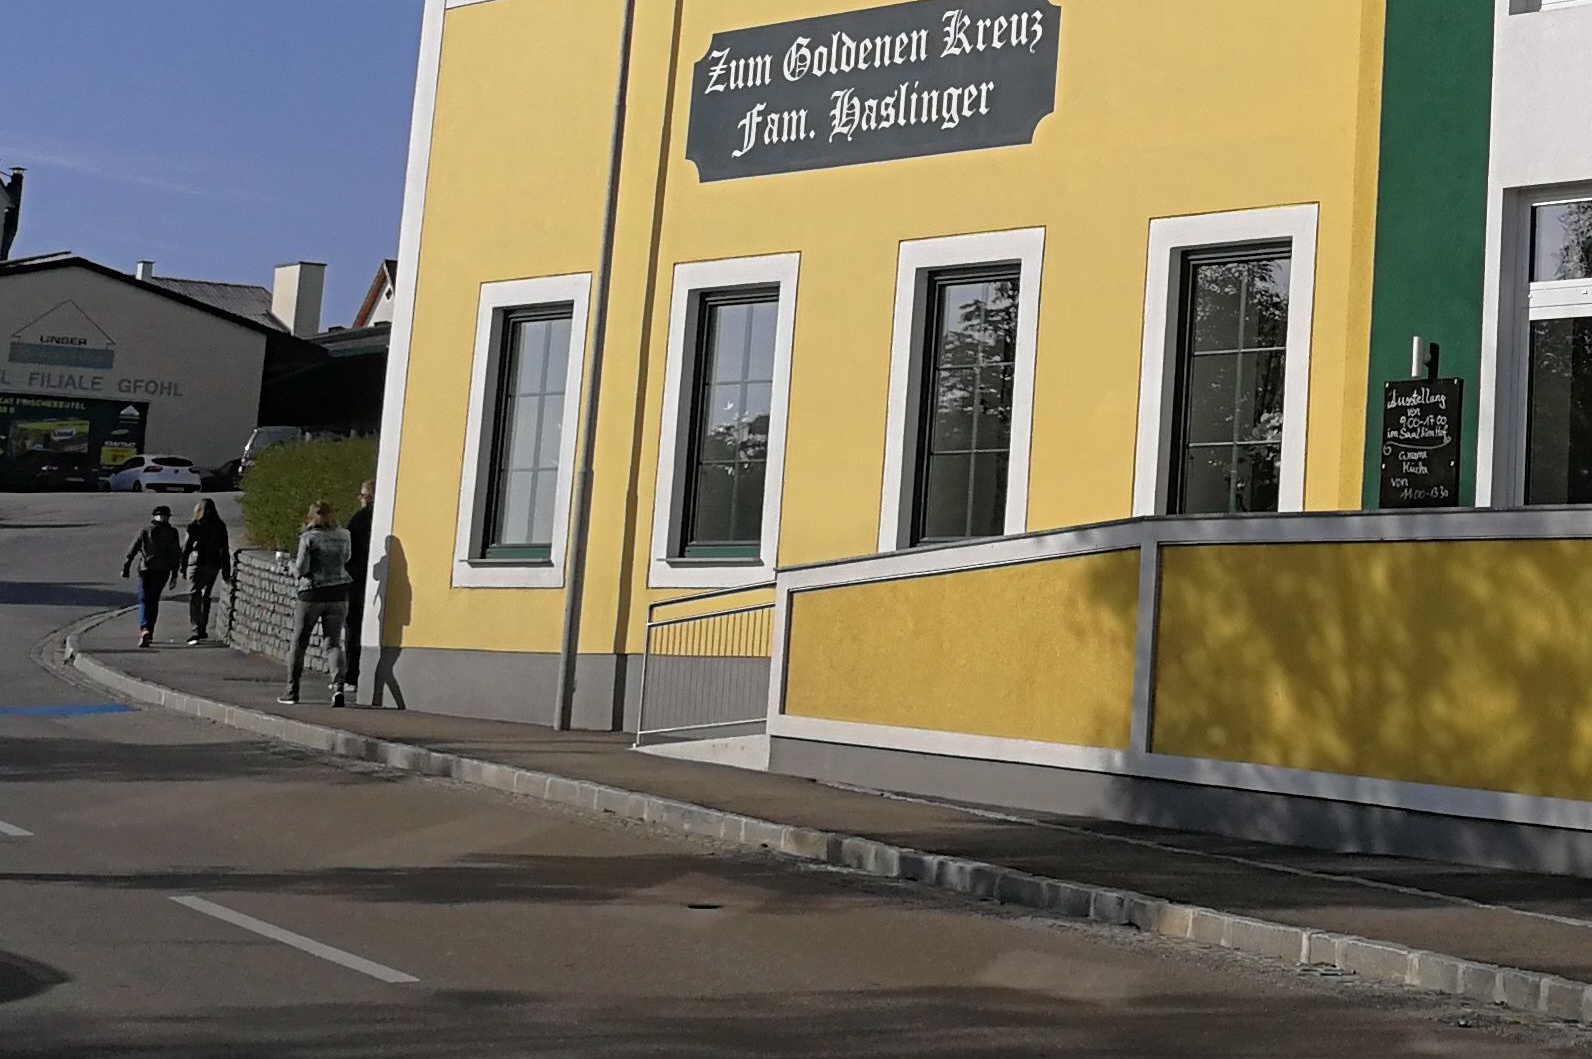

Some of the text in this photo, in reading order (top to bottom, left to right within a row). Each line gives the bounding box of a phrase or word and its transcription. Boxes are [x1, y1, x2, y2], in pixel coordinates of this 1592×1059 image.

[704, 8, 1044, 95] Zum Goldenen Kreuz
[731, 79, 995, 158] Fam. Haslinger
[28, 372, 104, 391] FILIALE
[1391, 478, 1409, 488] von
